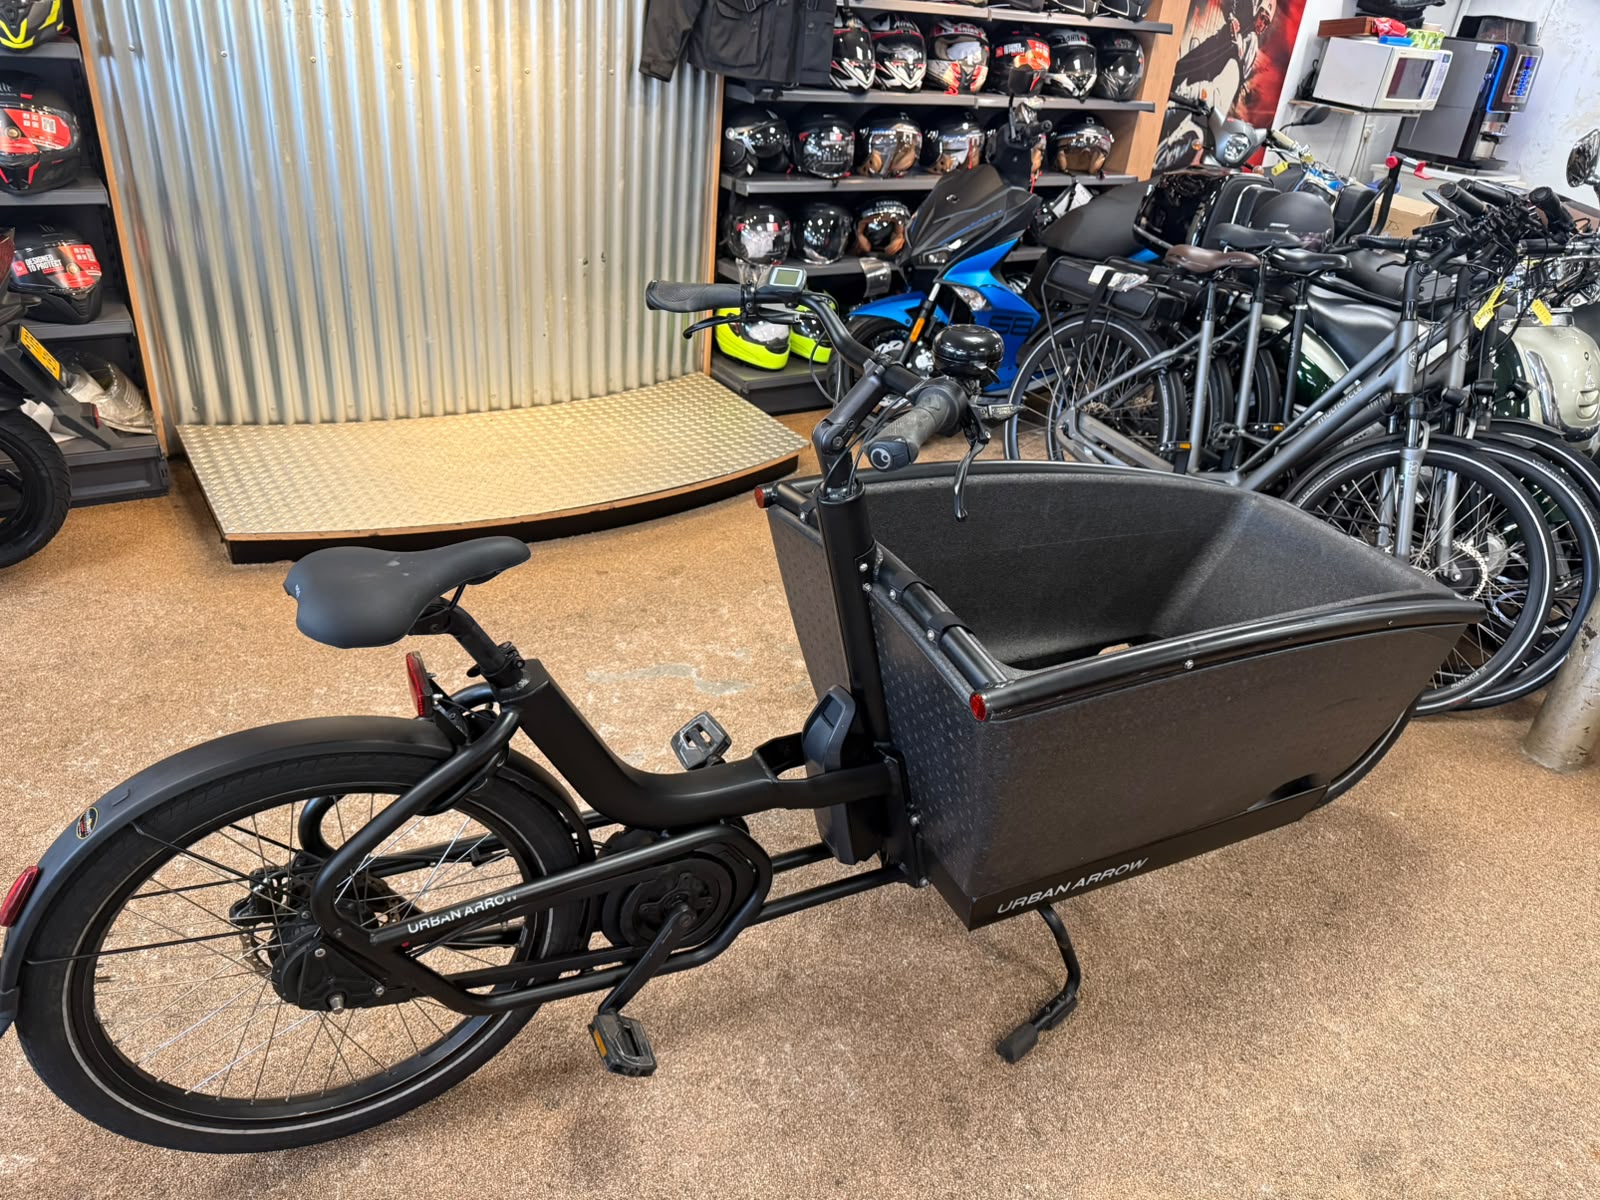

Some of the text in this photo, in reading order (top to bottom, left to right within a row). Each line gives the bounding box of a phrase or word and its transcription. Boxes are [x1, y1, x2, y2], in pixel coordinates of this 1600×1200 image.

[25, 254, 53, 266] DESIGNED
[28, 263, 37, 273] TO
[36, 259, 62, 271] PROTECT
[997, 857, 1149, 914] URBAN ARROW
[407, 909, 462, 934] URBAN
